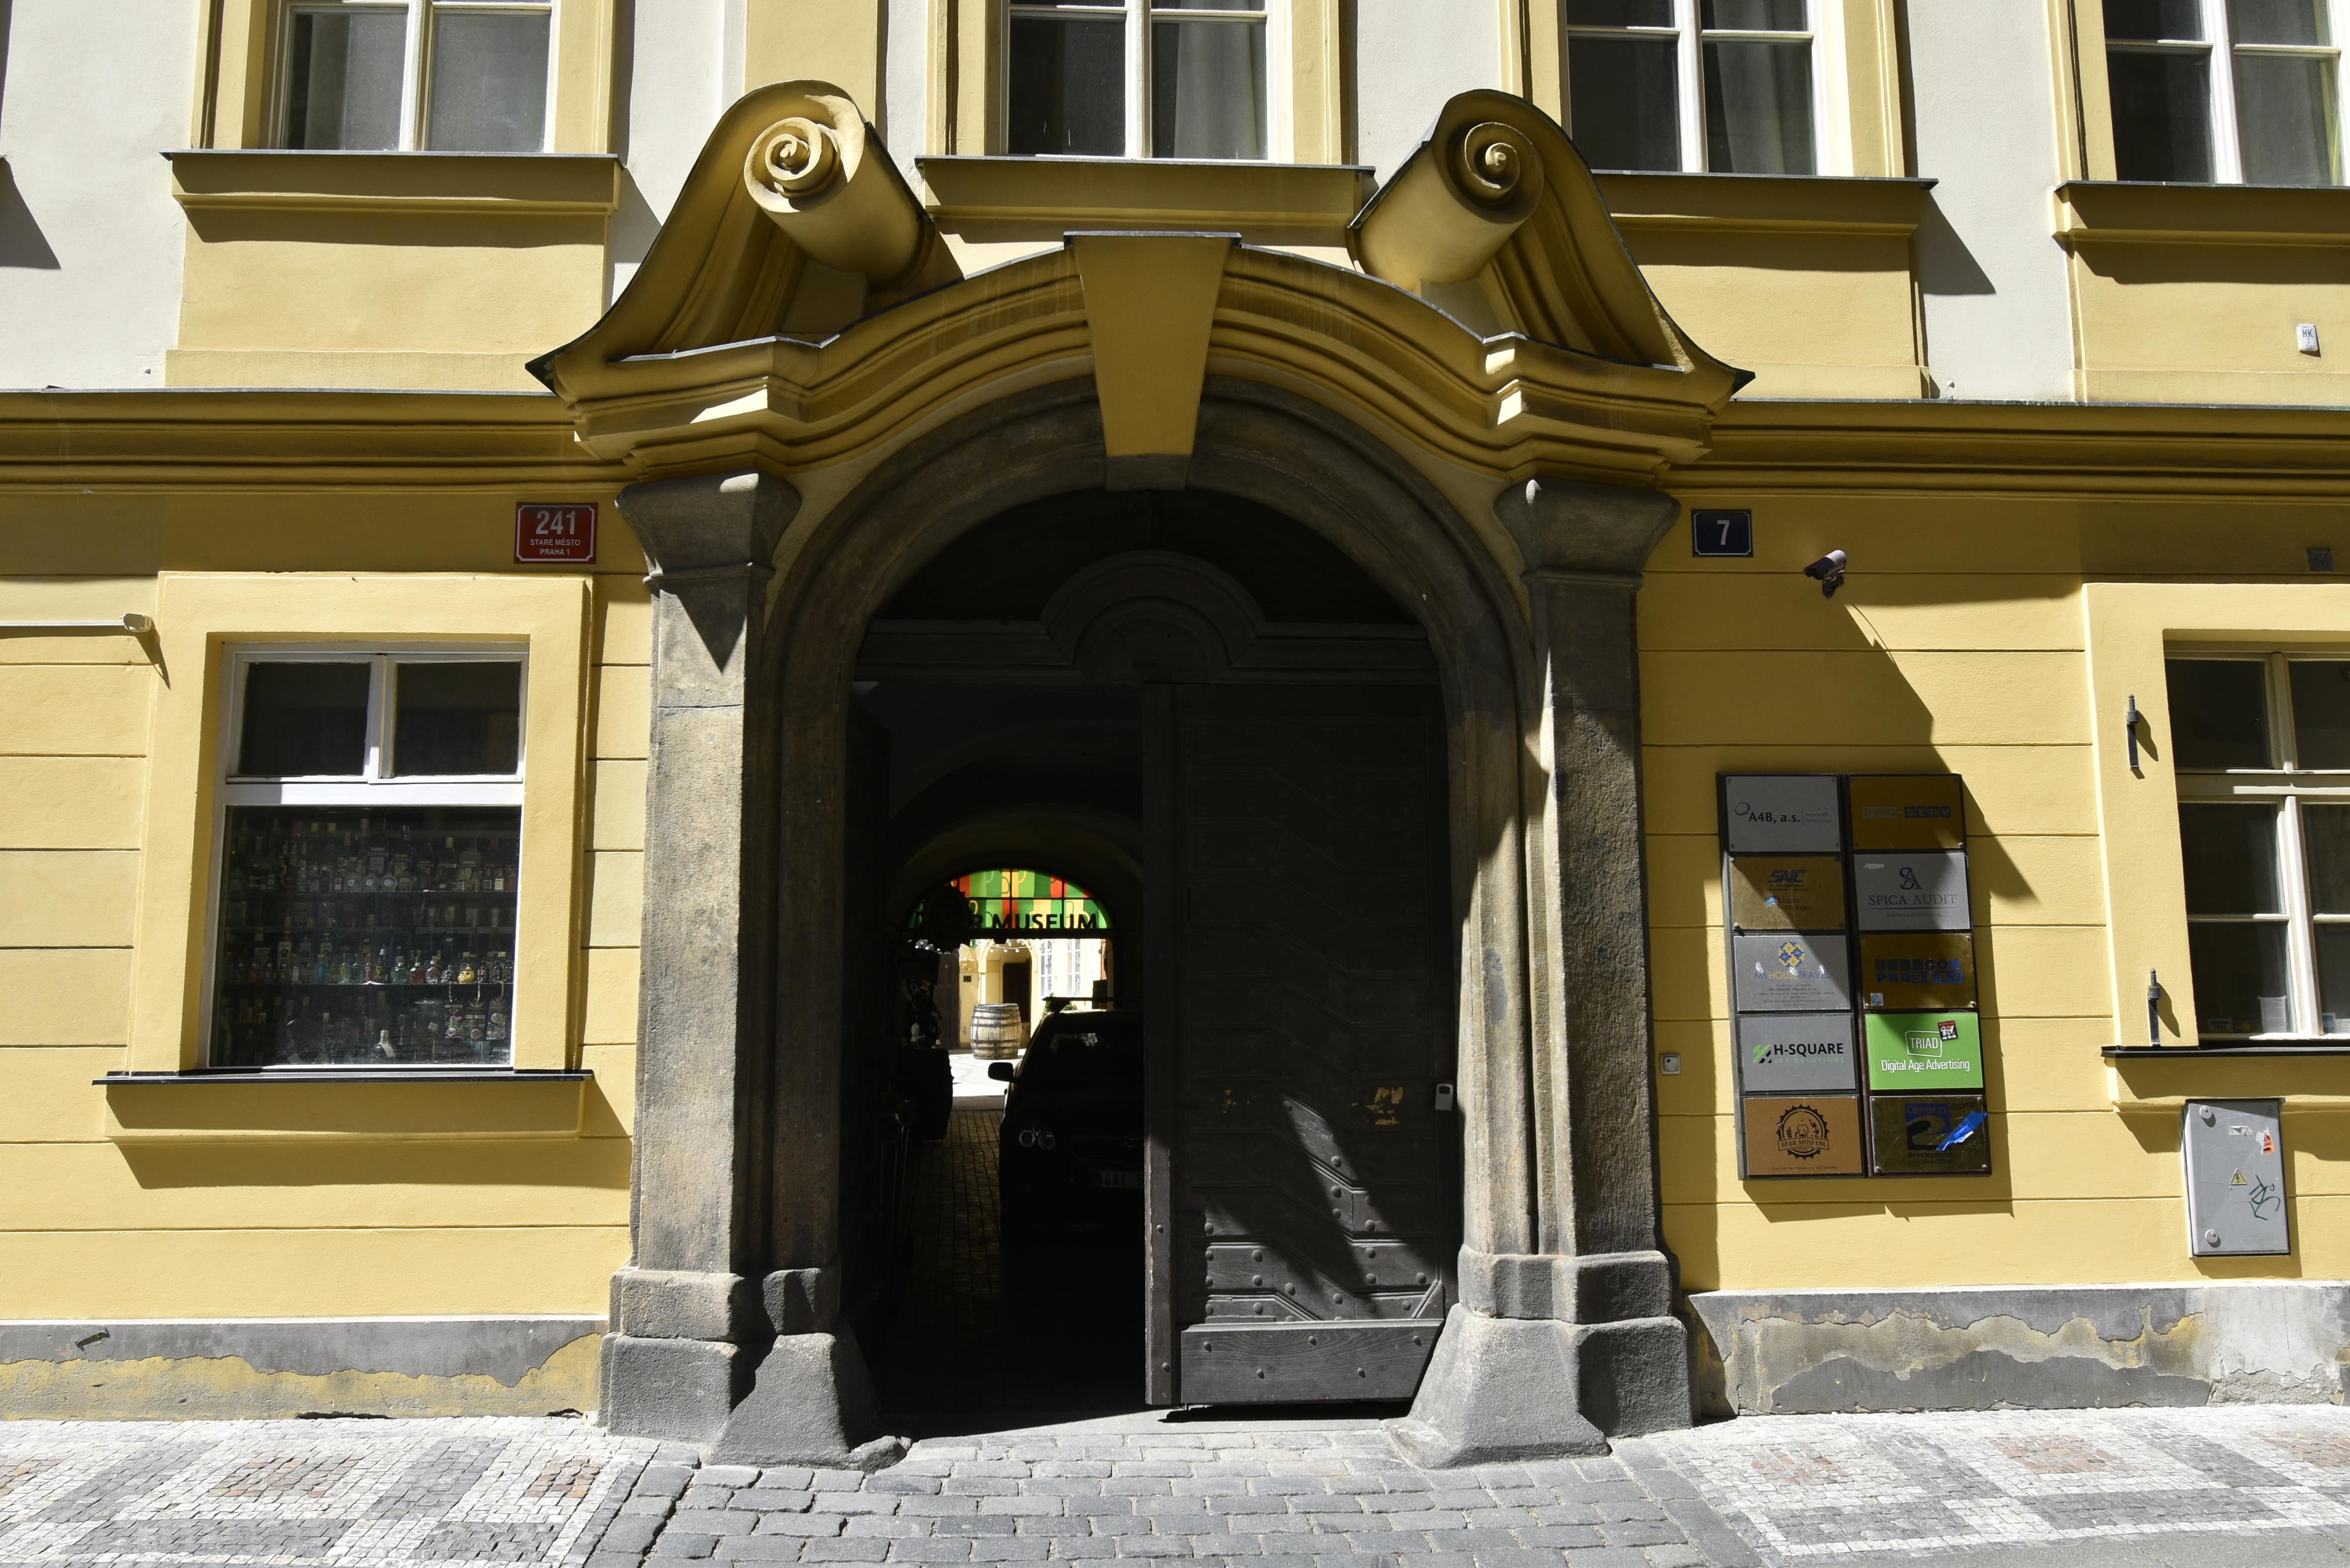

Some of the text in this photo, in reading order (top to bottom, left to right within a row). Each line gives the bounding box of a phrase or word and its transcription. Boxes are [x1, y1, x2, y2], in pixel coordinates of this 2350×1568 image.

[2302, 329, 2313, 338] HK
[535, 510, 576, 535] 241
[1717, 519, 1730, 545] 7
[530, 538, 553, 546] STARÉ
[1748, 812, 1800, 824] A4B, a.s.
[1768, 869, 1805, 882] SAIC
[1869, 894, 1957, 905] SPICA AUDIT
[992, 913, 1097, 929] MUSEUM
[1909, 1038, 1938, 1049] TRIAD
[1774, 1043, 1844, 1057] H-SQUARE
[1881, 1059, 1970, 1073] Digital Age Advertising
[1908, 1102, 1976, 1114] Connect Decimal
